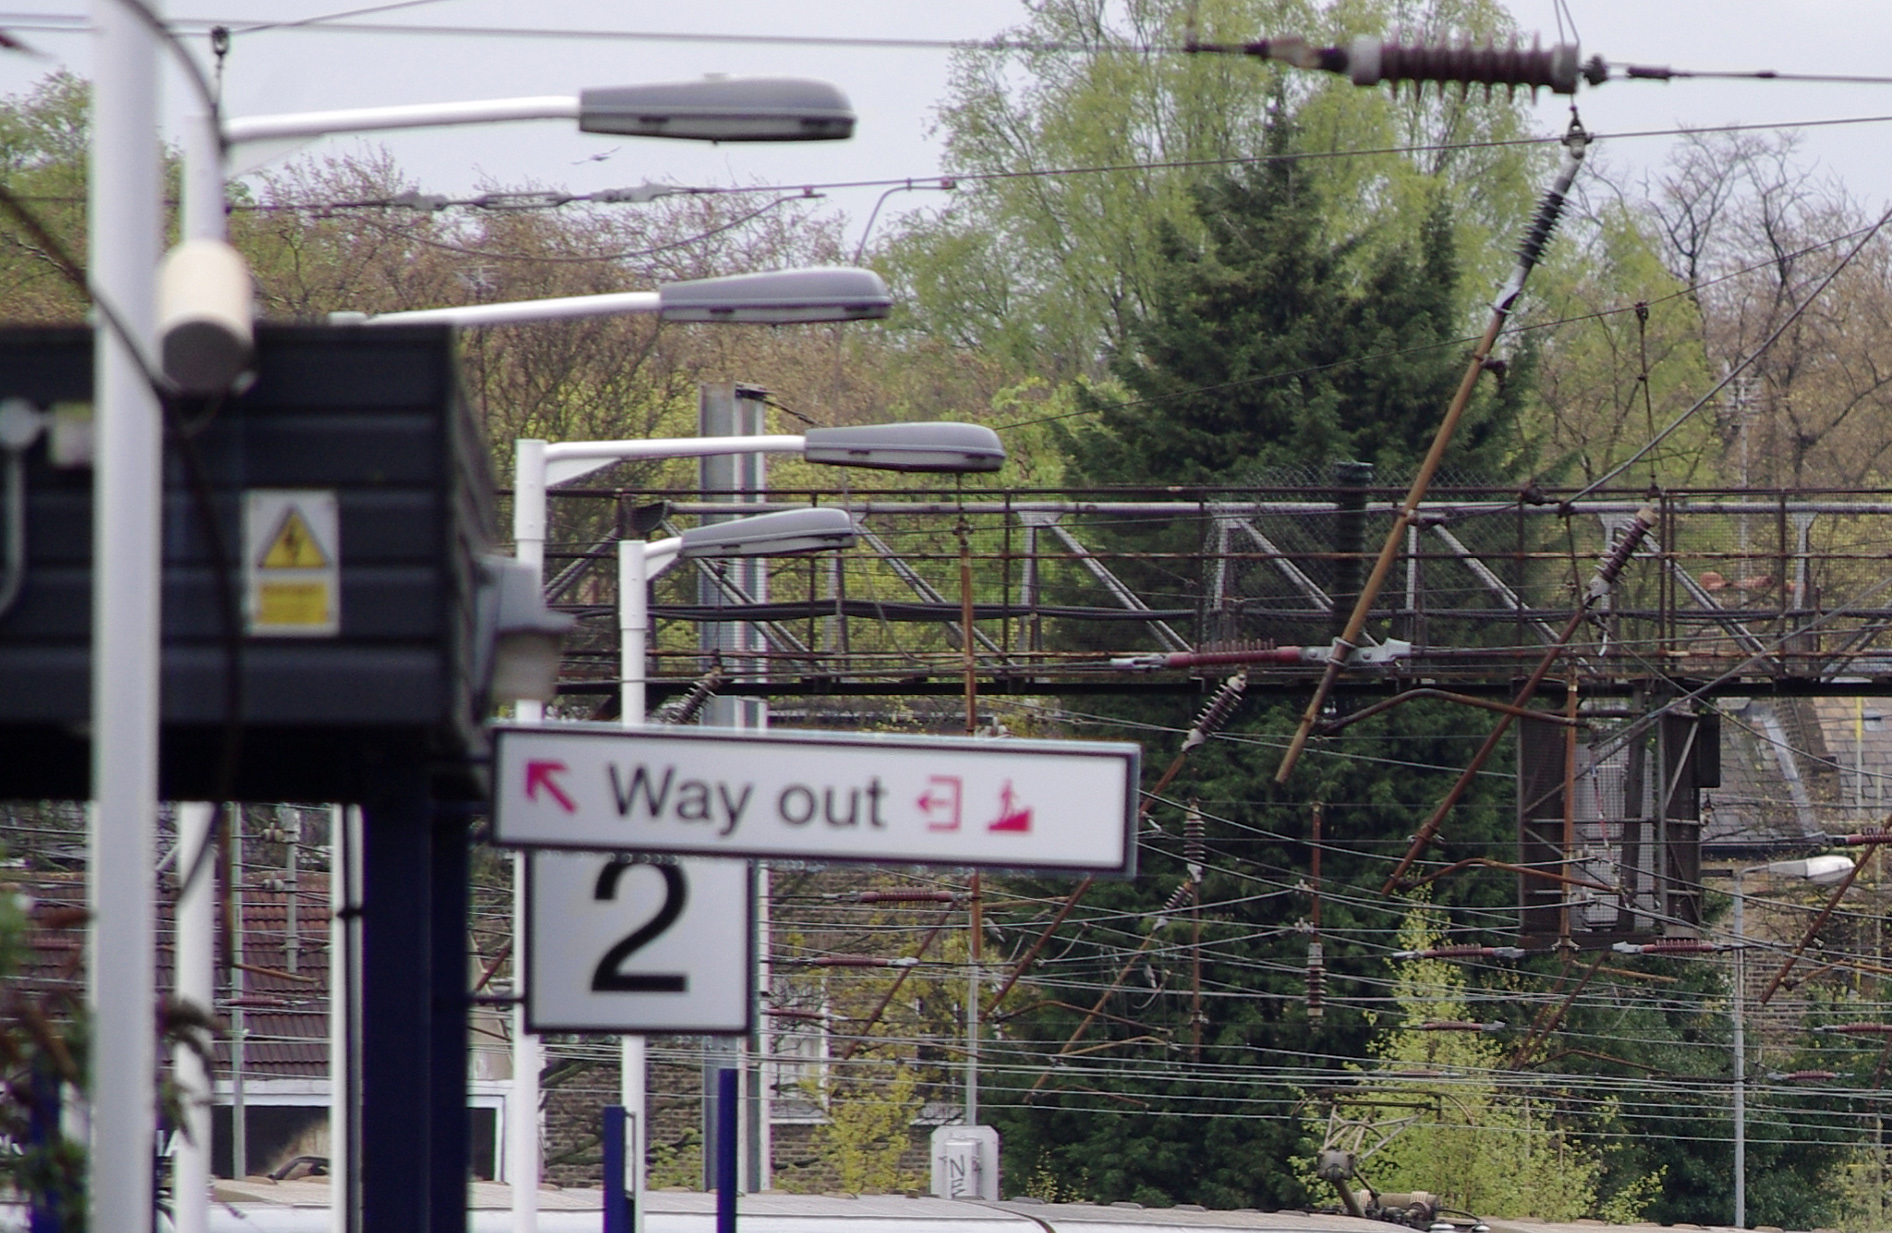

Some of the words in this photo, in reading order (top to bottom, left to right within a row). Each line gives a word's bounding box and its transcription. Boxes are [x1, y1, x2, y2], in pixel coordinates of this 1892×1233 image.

[608, 762, 754, 838] Way
[779, 776, 888, 829] out
[590, 858, 689, 993] 2
